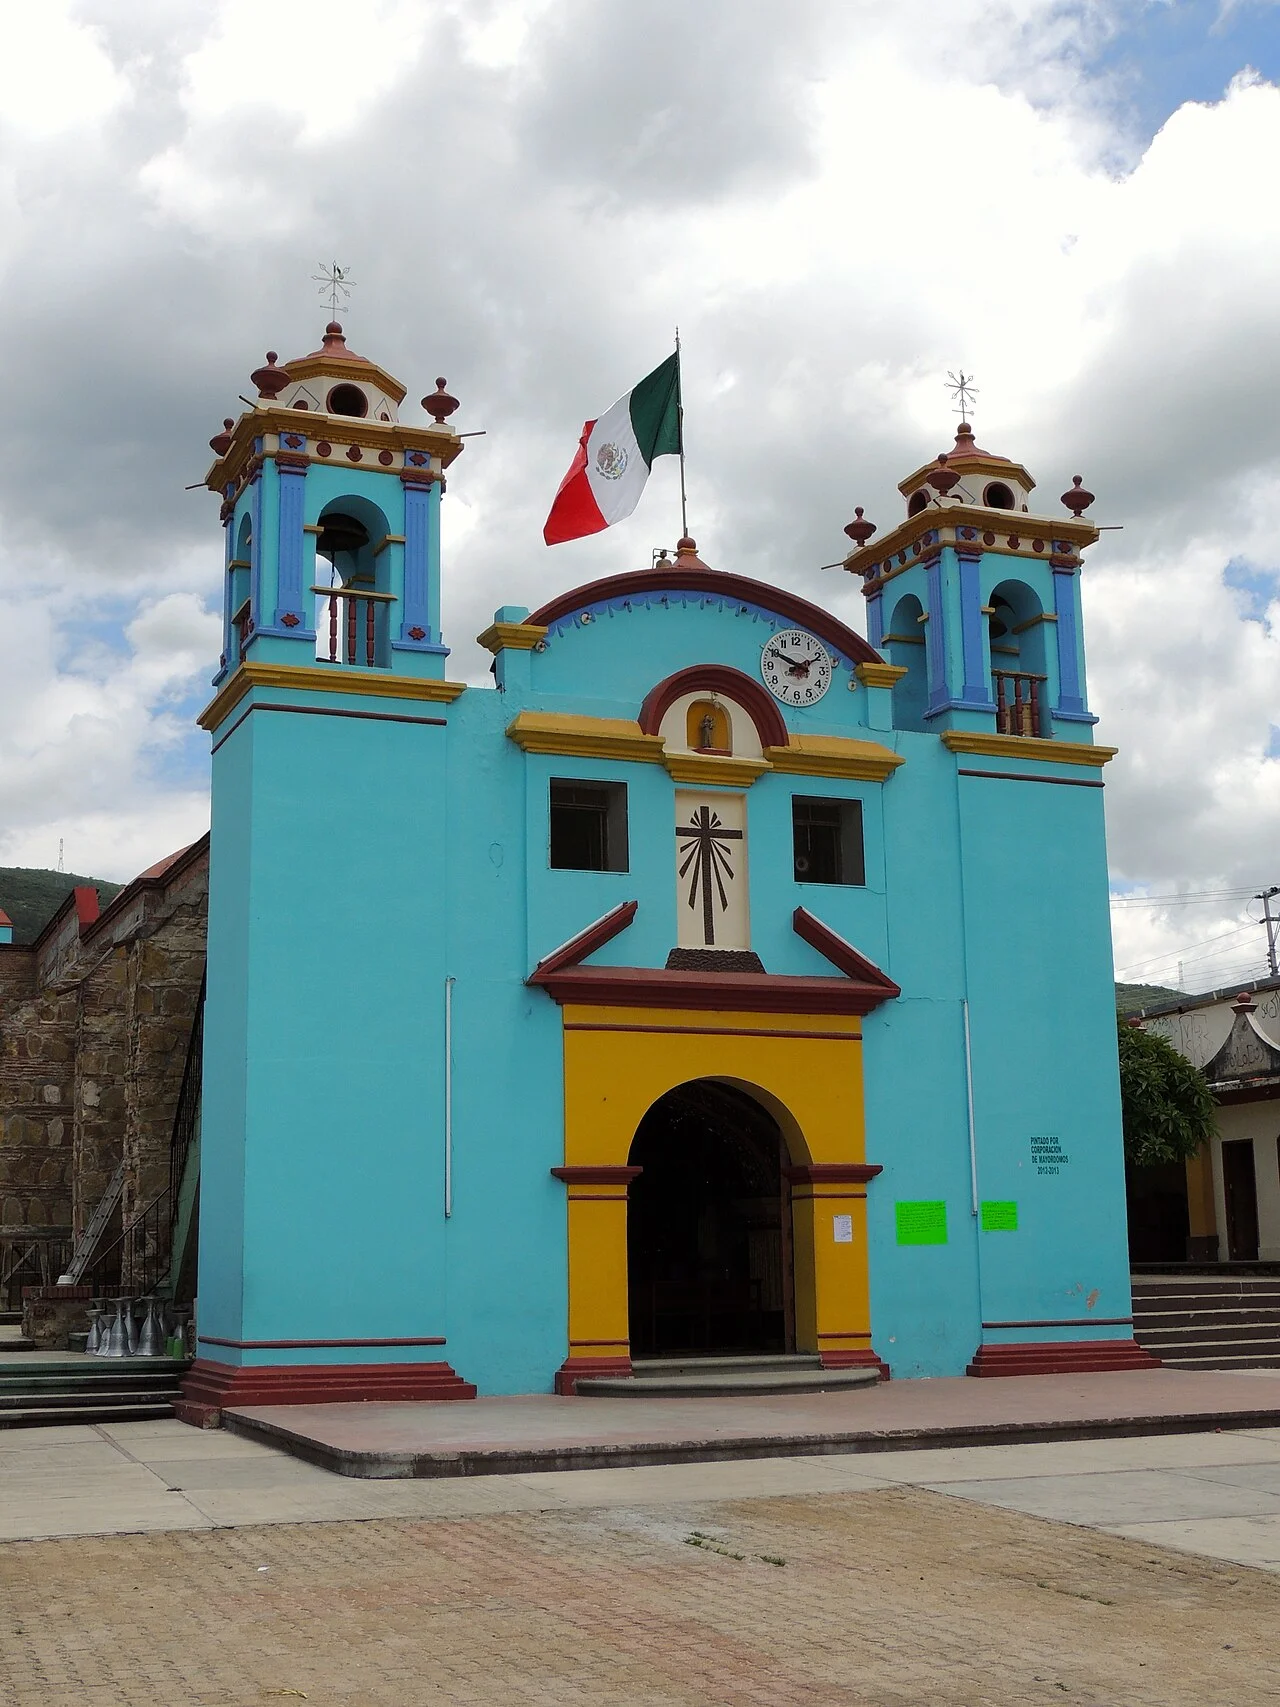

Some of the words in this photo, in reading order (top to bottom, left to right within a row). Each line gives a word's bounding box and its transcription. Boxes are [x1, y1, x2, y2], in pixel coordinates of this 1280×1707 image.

[780, 639, 787, 649] 11
[791, 636, 801, 647] 12
[806, 641, 810, 651] 1
[770, 648, 780, 658] 10
[814, 652, 821, 662] 2
[766, 661, 774, 671] 9
[818, 666, 826, 676] 3
[771, 674, 779, 685] 8
[814, 679, 822, 688] 4
[782, 685, 789, 695] 7
[793, 690, 801, 700] 6
[805, 688, 813, 698] 5
[1030, 1136, 1050, 1145] PINTADO
[1050, 1136, 1059, 1145] POR
[1032, 1155, 1038, 1164] DE
[1038, 1155, 1069, 1164] MAYORDOMOS
